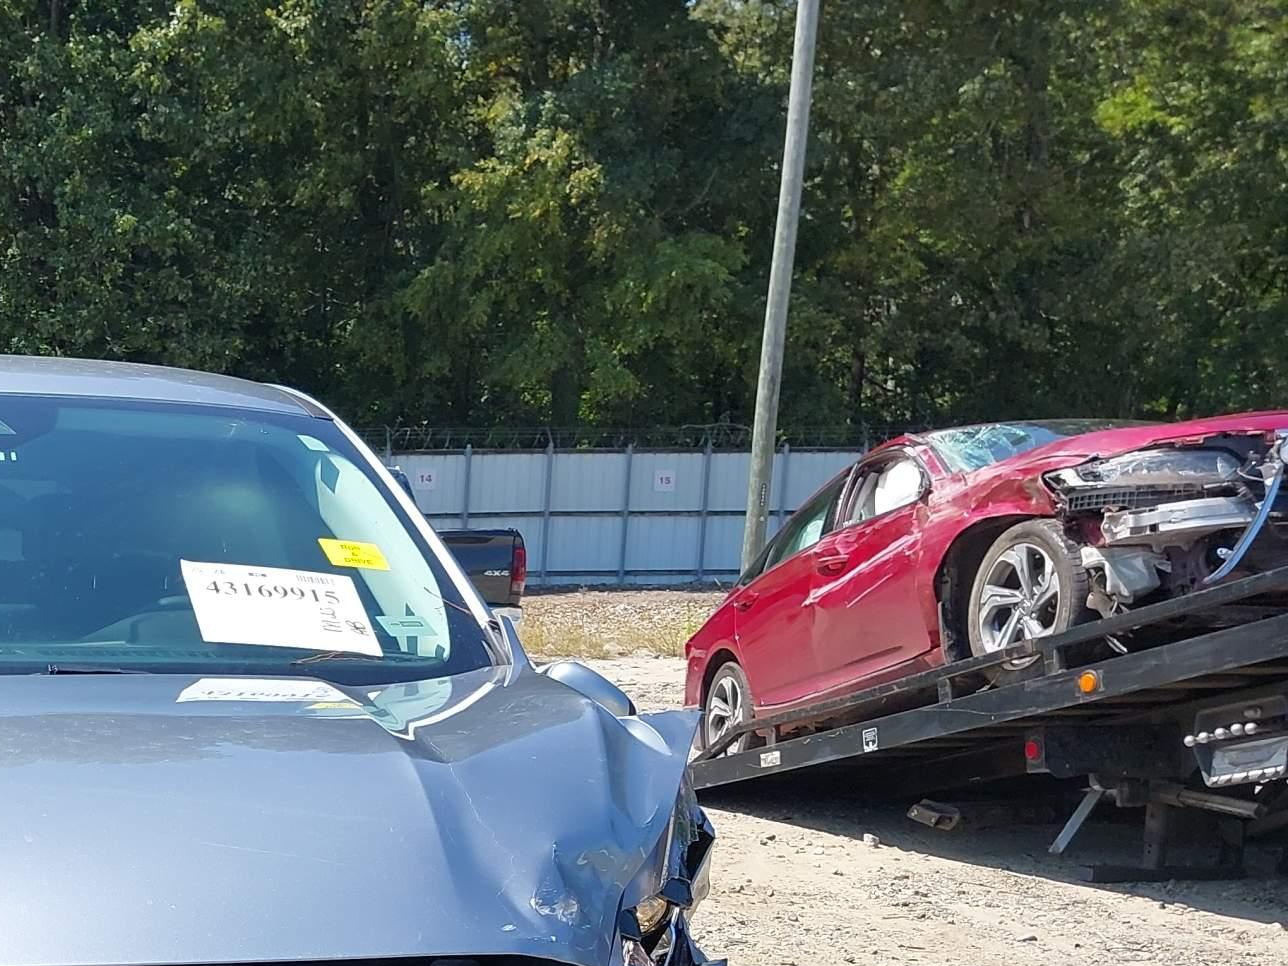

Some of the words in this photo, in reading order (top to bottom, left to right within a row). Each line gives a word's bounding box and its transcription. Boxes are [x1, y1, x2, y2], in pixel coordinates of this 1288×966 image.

[420, 474, 433, 483] 14
[659, 476, 672, 485] 15
[206, 580, 340, 604] 43169915
